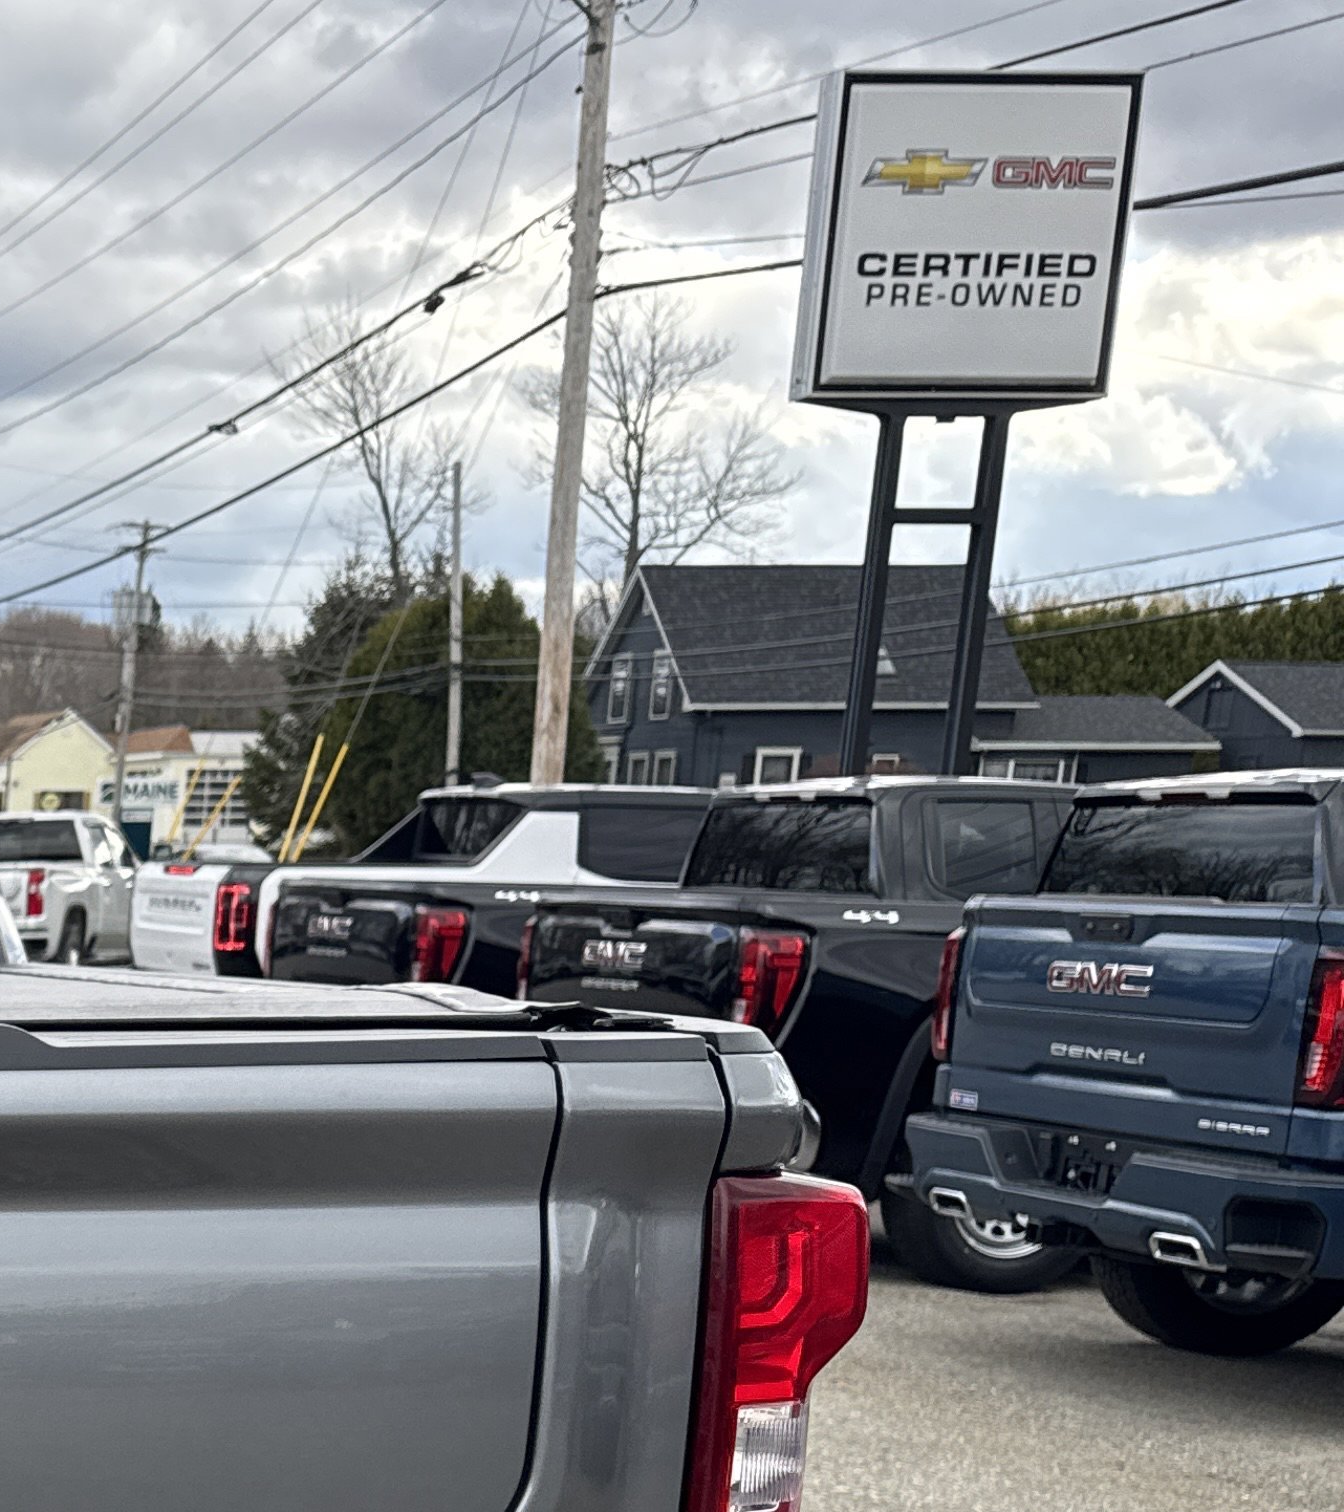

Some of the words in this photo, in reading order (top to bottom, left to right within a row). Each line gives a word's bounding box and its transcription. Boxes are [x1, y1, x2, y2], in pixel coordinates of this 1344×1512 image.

[992, 156, 1116, 189] GMC
[857, 253, 1097, 278] CERTIFIED
[865, 283, 1082, 307] PRE-OWNED
[123, 781, 179, 800] MAINE
[1047, 960, 1154, 998] GMC
[1050, 1042, 1146, 1065] DENALI
[1197, 1118, 1270, 1136] SIERRA
